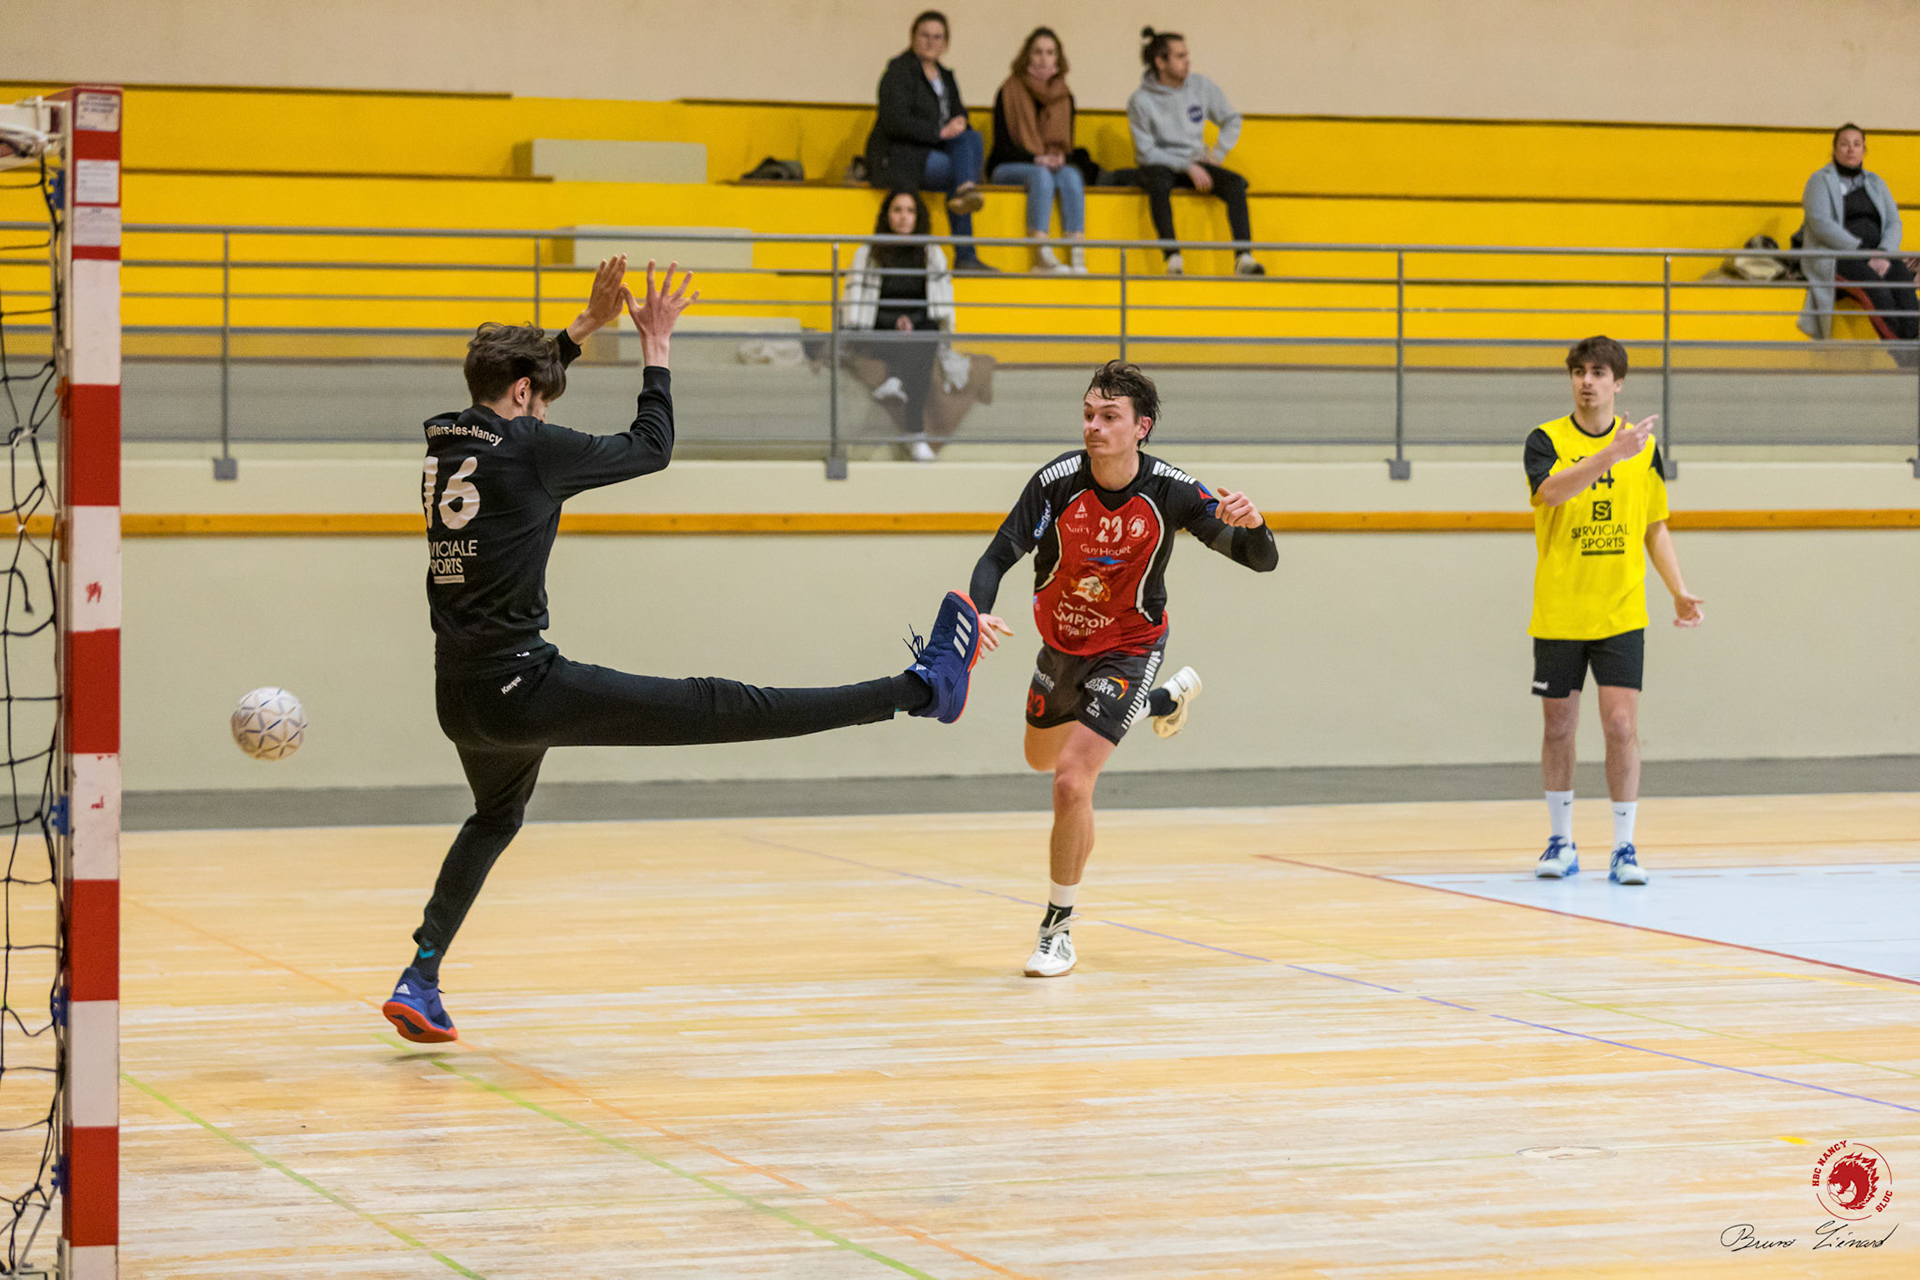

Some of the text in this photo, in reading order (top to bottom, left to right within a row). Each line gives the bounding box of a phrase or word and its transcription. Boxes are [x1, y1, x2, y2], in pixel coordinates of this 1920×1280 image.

[423, 456, 480, 530] 16
[428, 540, 478, 557] VICIALE
[1581, 537, 1625, 549] SPORTS
[430, 558, 464, 575] PORTS
